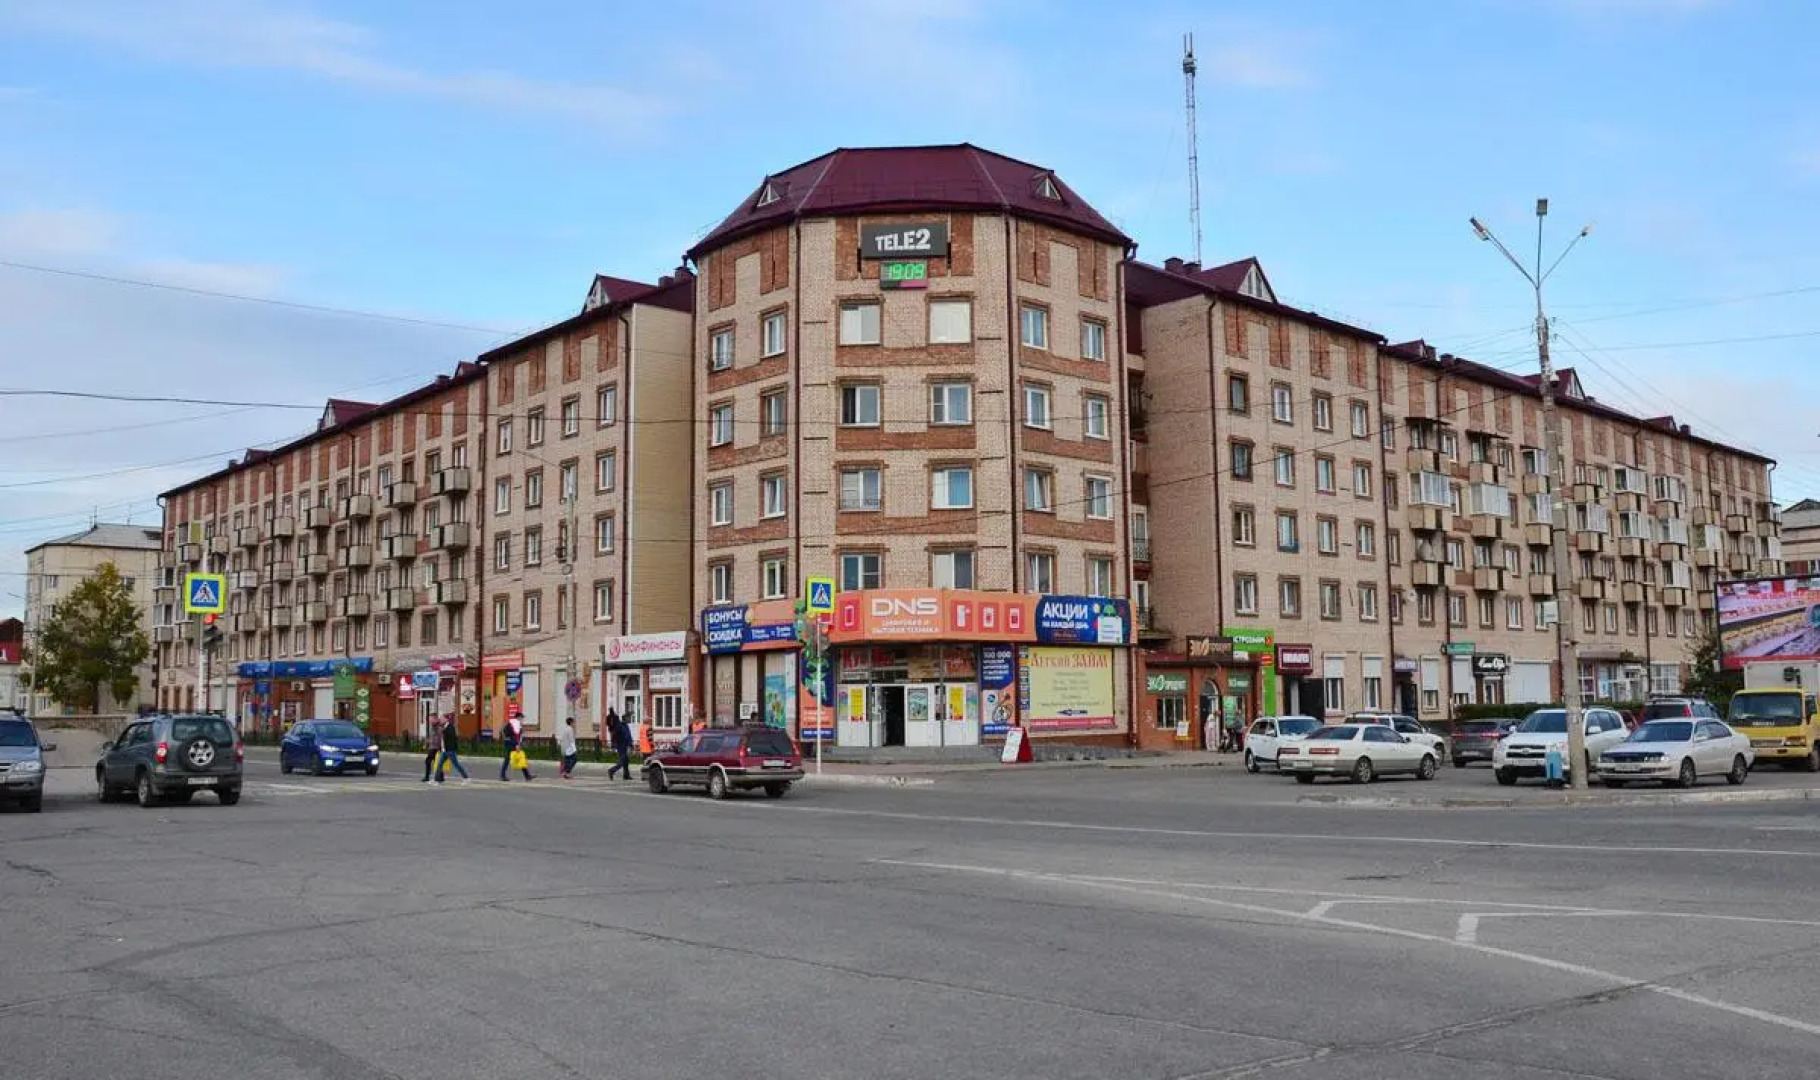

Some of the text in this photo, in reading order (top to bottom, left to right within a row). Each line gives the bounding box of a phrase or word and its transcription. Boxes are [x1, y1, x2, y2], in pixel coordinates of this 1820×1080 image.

[875, 228, 931, 251] TELE2
[872, 598, 938, 616] DNS
[1042, 602, 1088, 621] АКЦИИ
[709, 609, 743, 624] БОНУСЫ
[709, 628, 743, 643] СКИДКА
